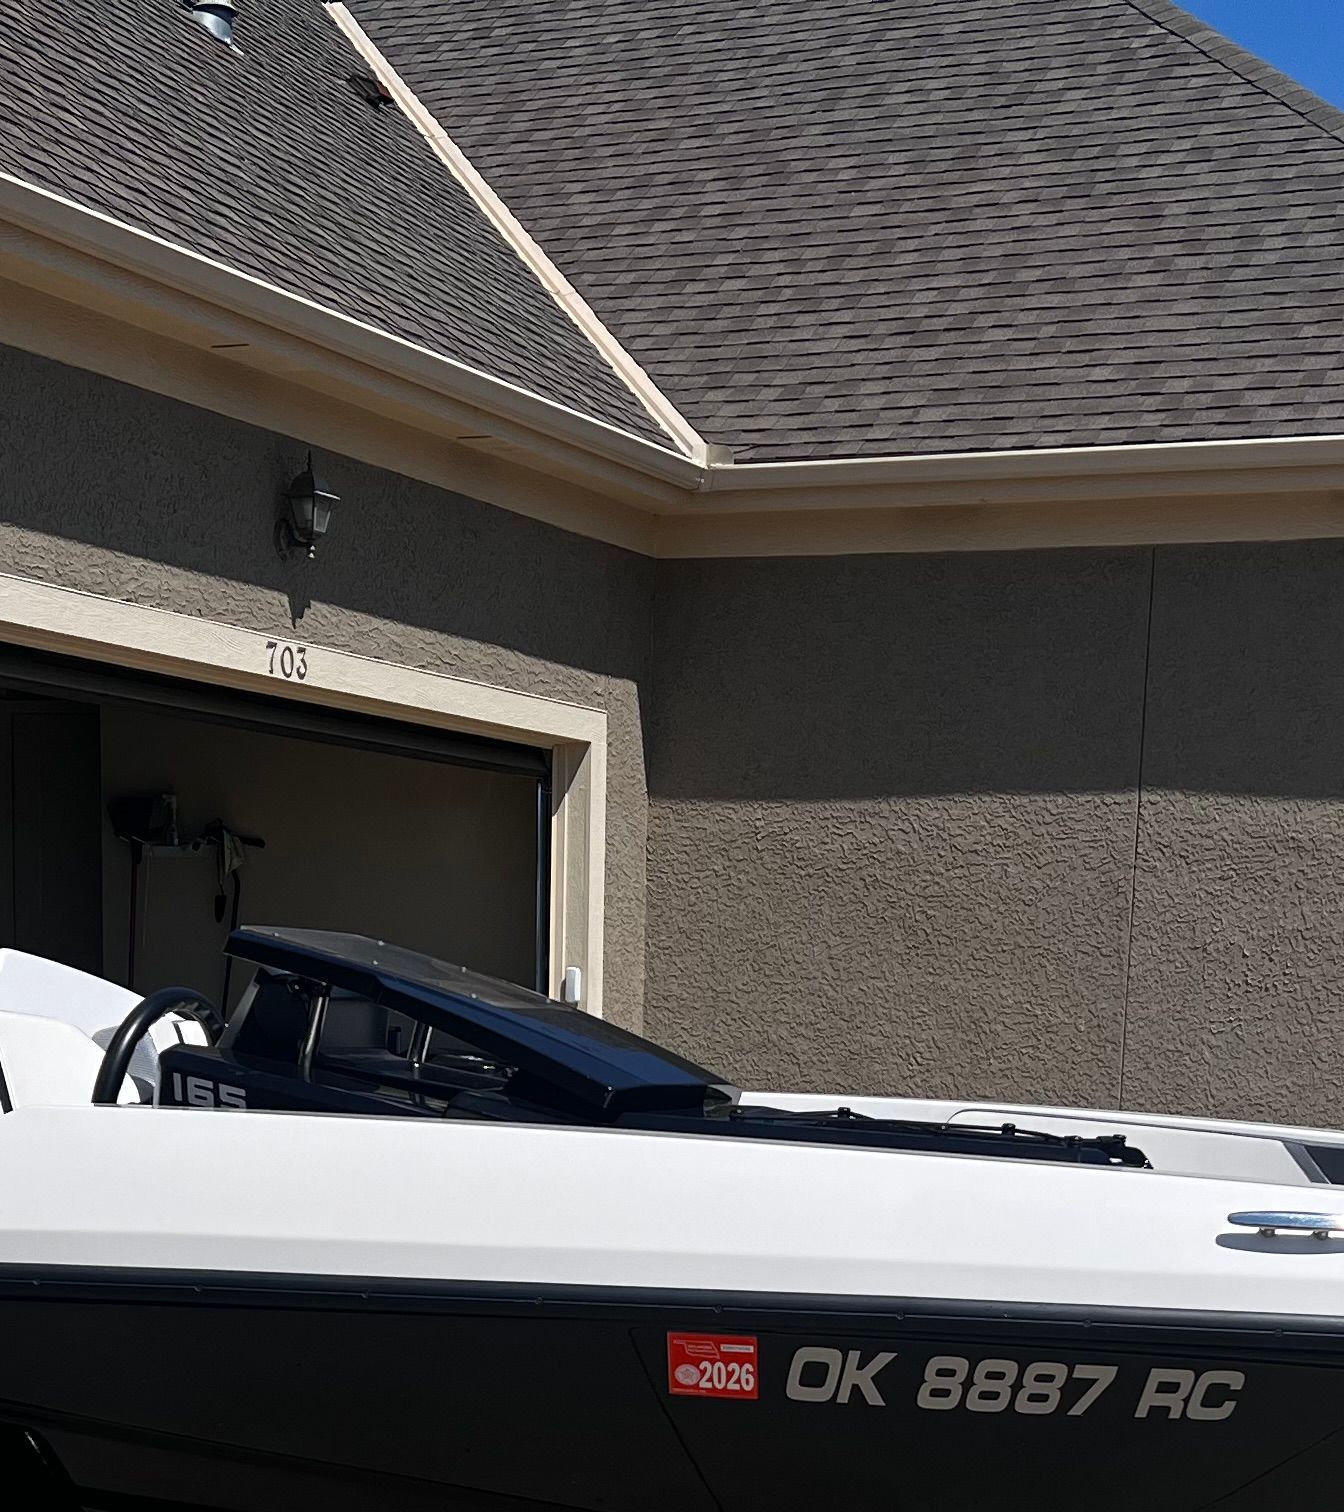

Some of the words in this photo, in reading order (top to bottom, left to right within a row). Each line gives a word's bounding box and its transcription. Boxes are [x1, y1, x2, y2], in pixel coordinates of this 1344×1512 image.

[265, 640, 308, 680] 703
[172, 1072, 247, 1109] 165
[698, 1360, 755, 1391] 2026
[785, 1346, 898, 1407] OK
[915, 1354, 1119, 1418] 8887
[1133, 1367, 1246, 1422] RC
